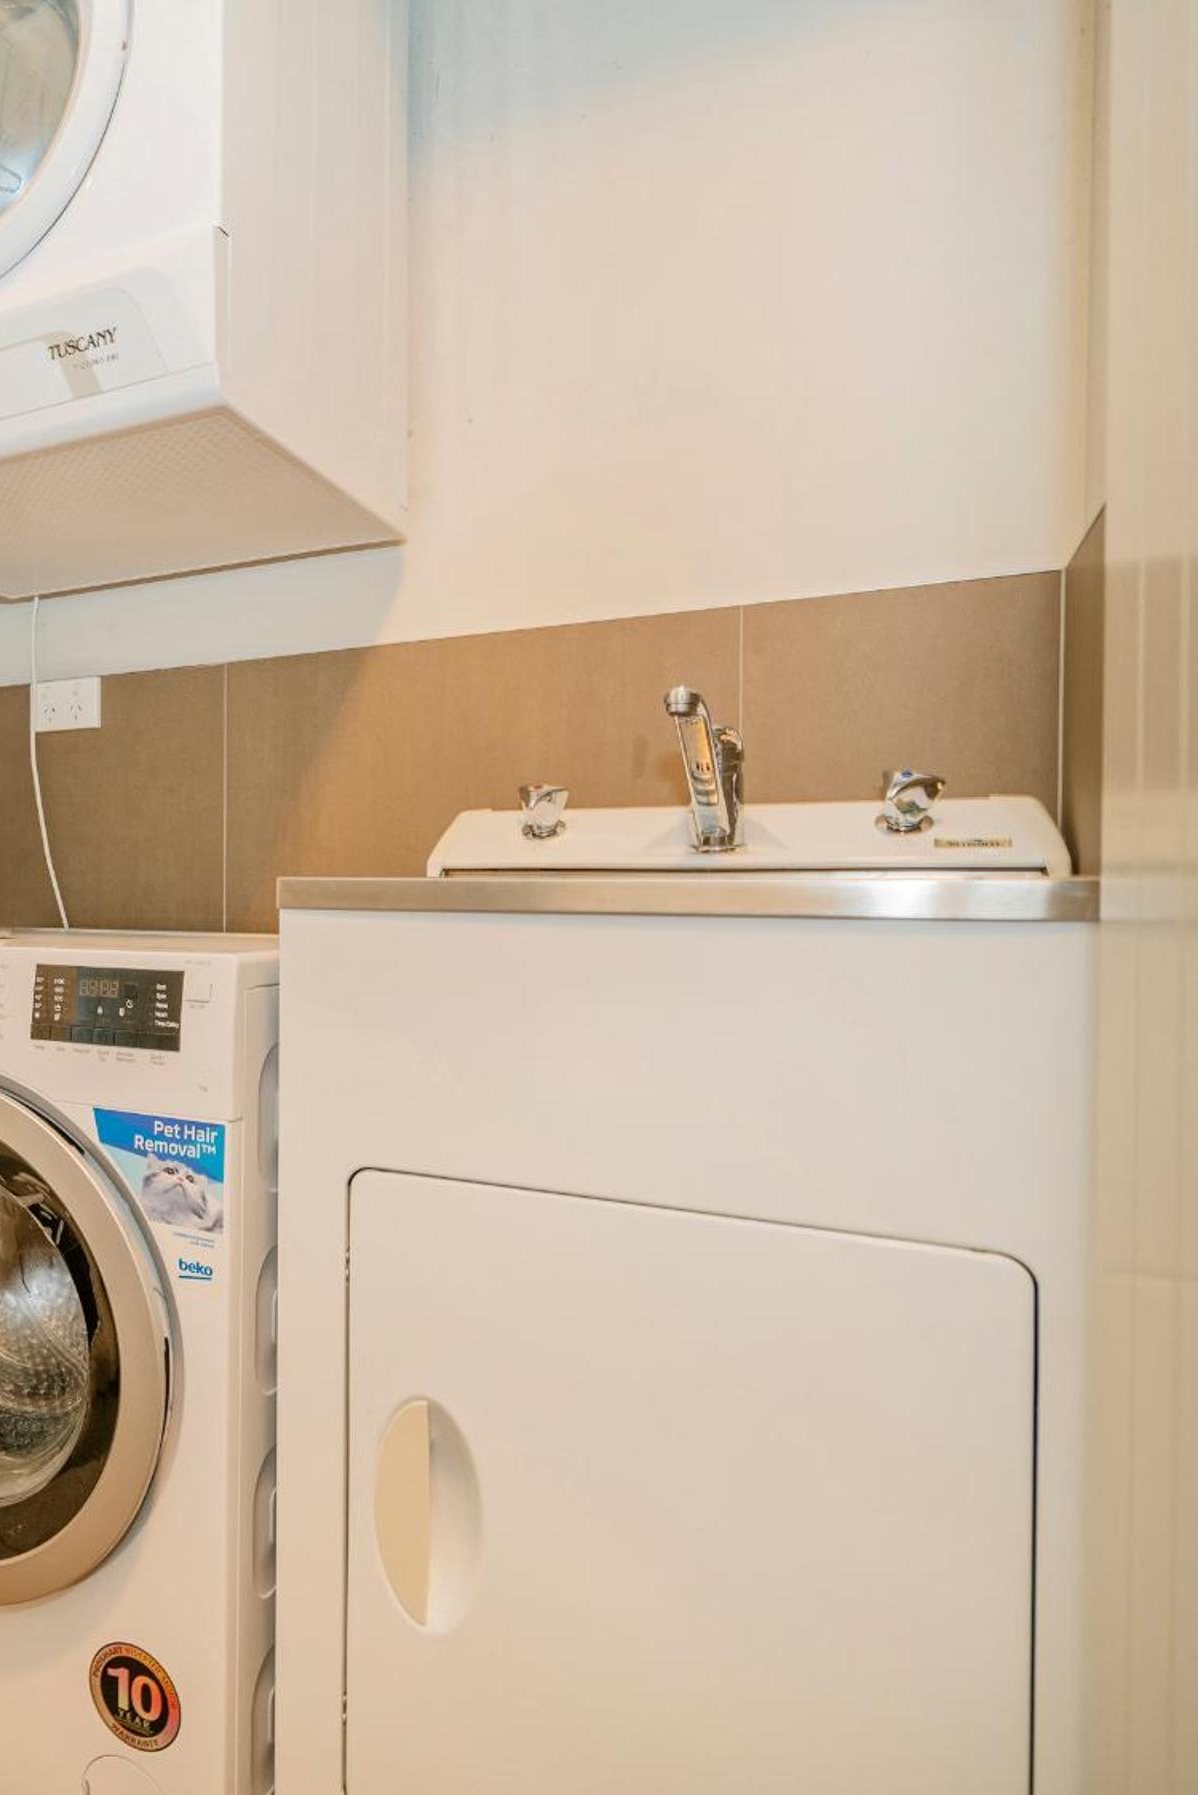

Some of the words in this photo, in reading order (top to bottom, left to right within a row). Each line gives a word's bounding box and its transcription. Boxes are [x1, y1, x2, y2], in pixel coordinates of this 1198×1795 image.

[48, 327, 117, 361] TUSCANY
[154, 1121, 181, 1139] Pet
[183, 1125, 218, 1143] Hair
[134, 1134, 217, 1159] Removal™
[178, 1258, 213, 1277] beko
[106, 1667, 163, 1722] 10
